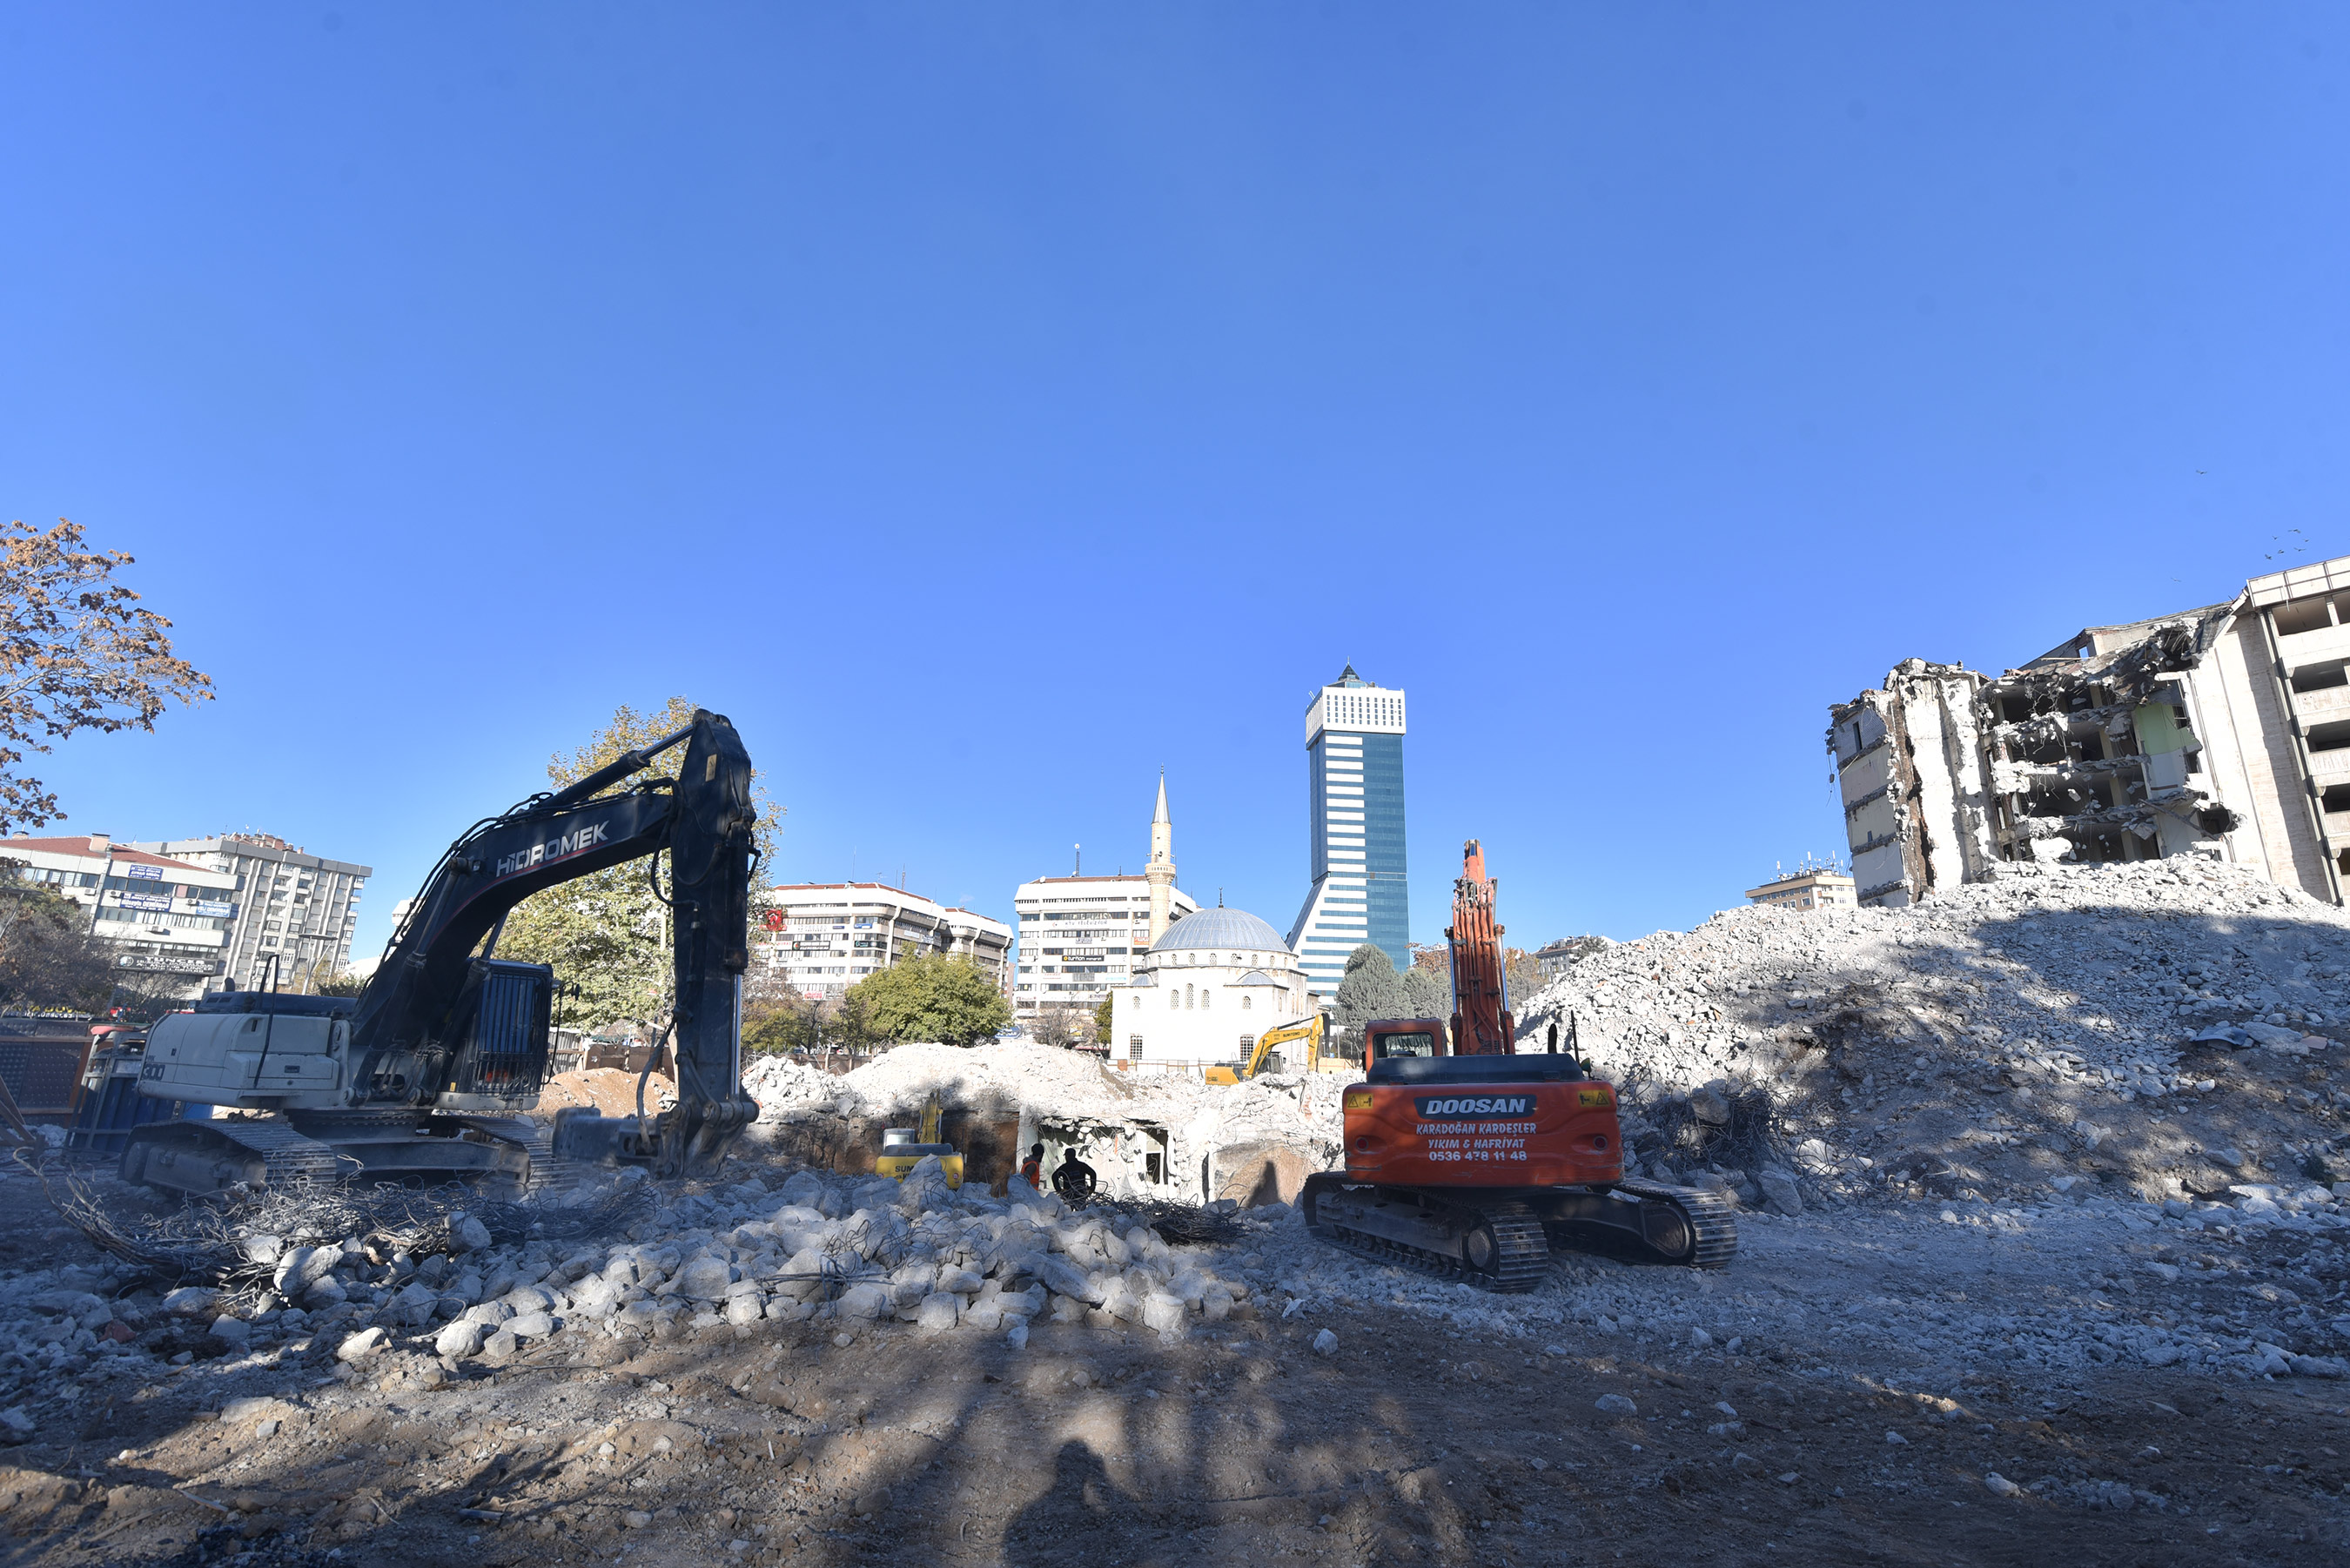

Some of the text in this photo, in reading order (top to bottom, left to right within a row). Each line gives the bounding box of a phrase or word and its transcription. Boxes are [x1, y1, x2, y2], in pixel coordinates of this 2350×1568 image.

[1426, 1098, 1526, 1115] DOOSAN
[1416, 1121, 1537, 1136] KARADOĞAN KARDEŞLER
[1428, 1136, 1525, 1149] YIKIM & HAFRİYAT
[1428, 1150, 1528, 1161] 0536 478 11 48
